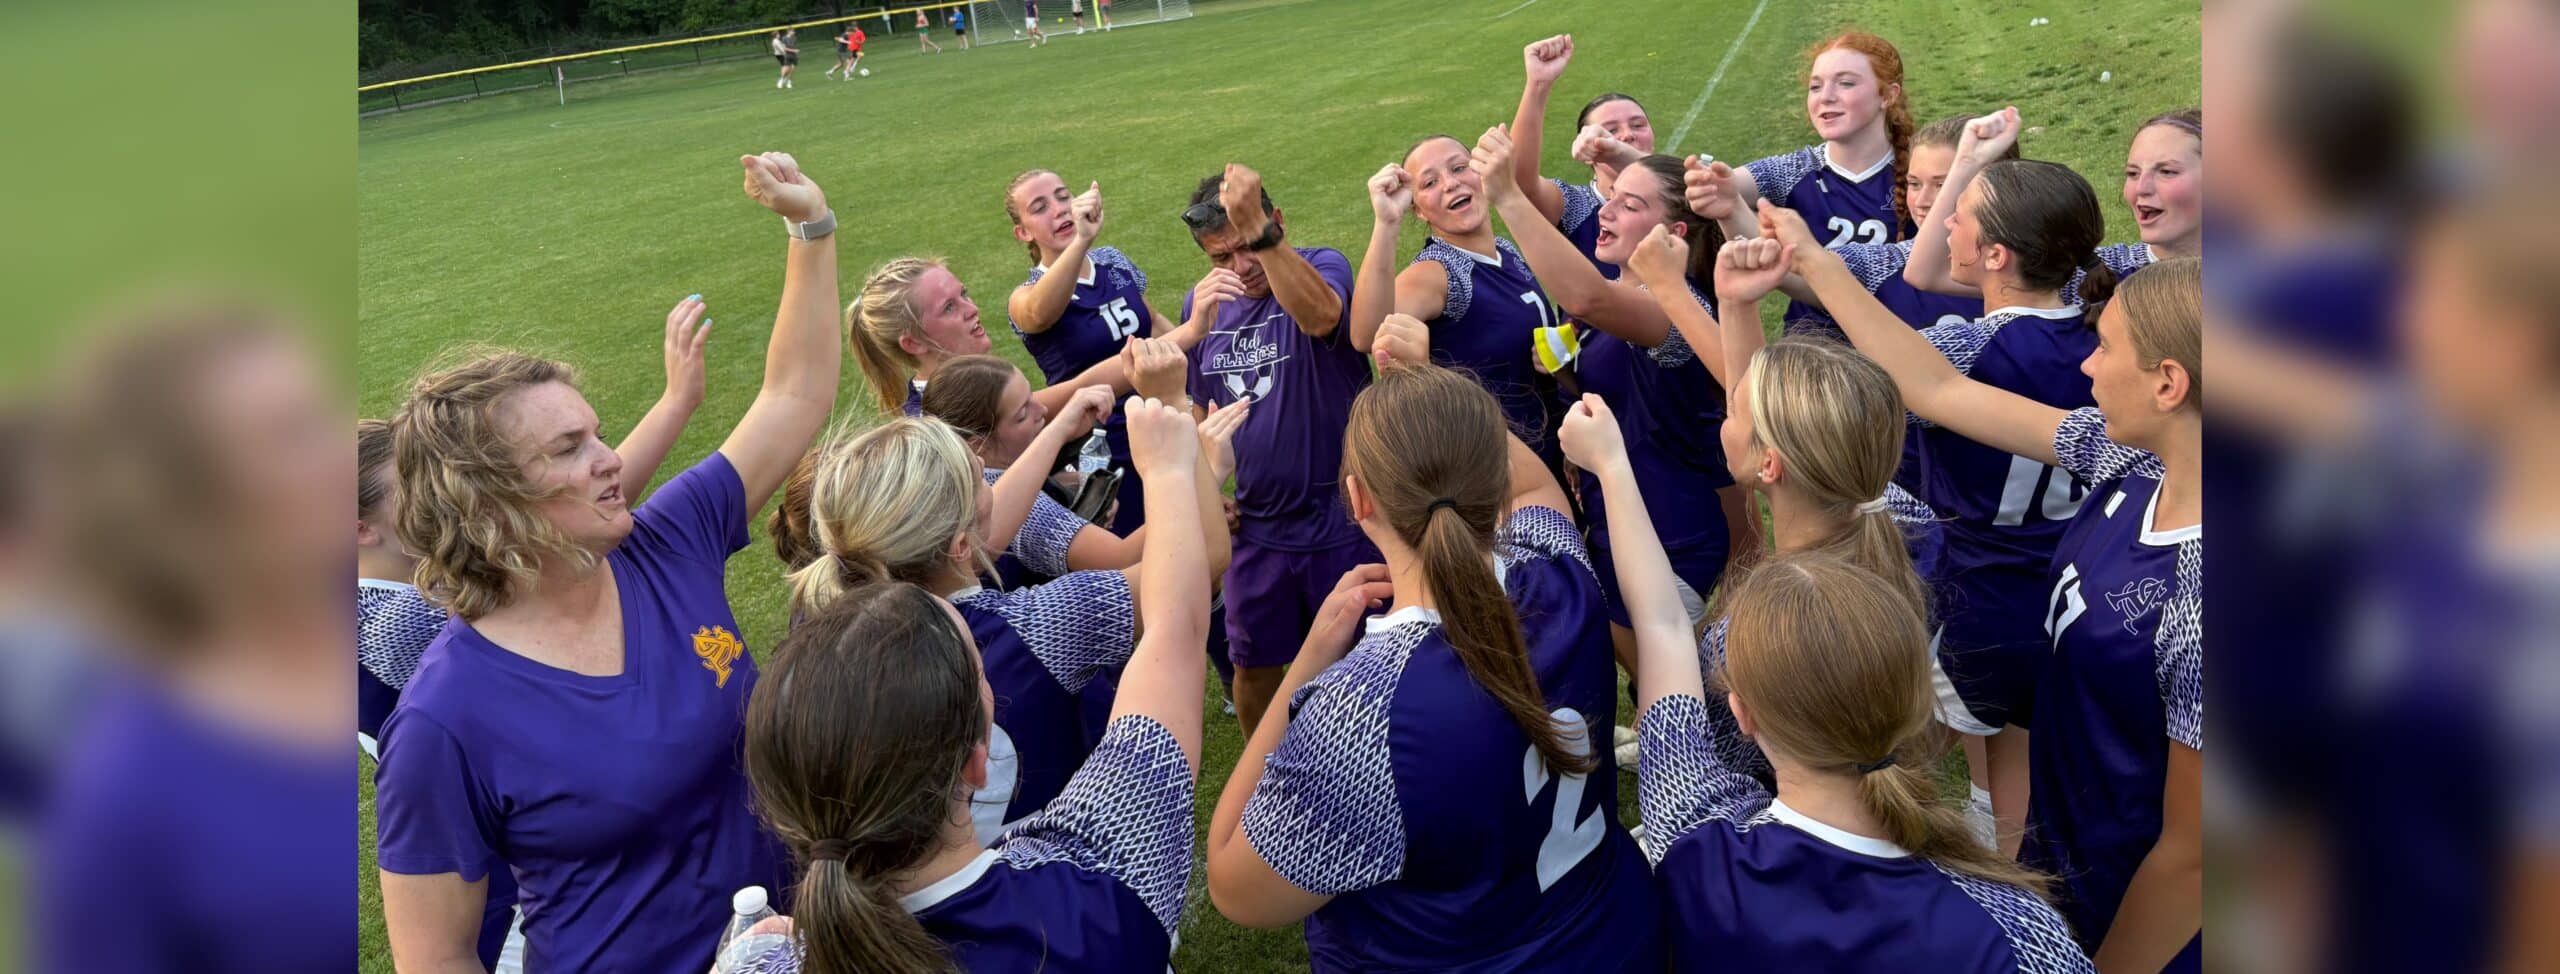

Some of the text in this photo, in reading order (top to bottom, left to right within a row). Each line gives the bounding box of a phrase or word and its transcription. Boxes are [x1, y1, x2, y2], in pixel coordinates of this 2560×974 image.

[1824, 216, 1888, 247] 22
[1099, 296, 1140, 341] 15
[1523, 707, 1608, 894] 2
